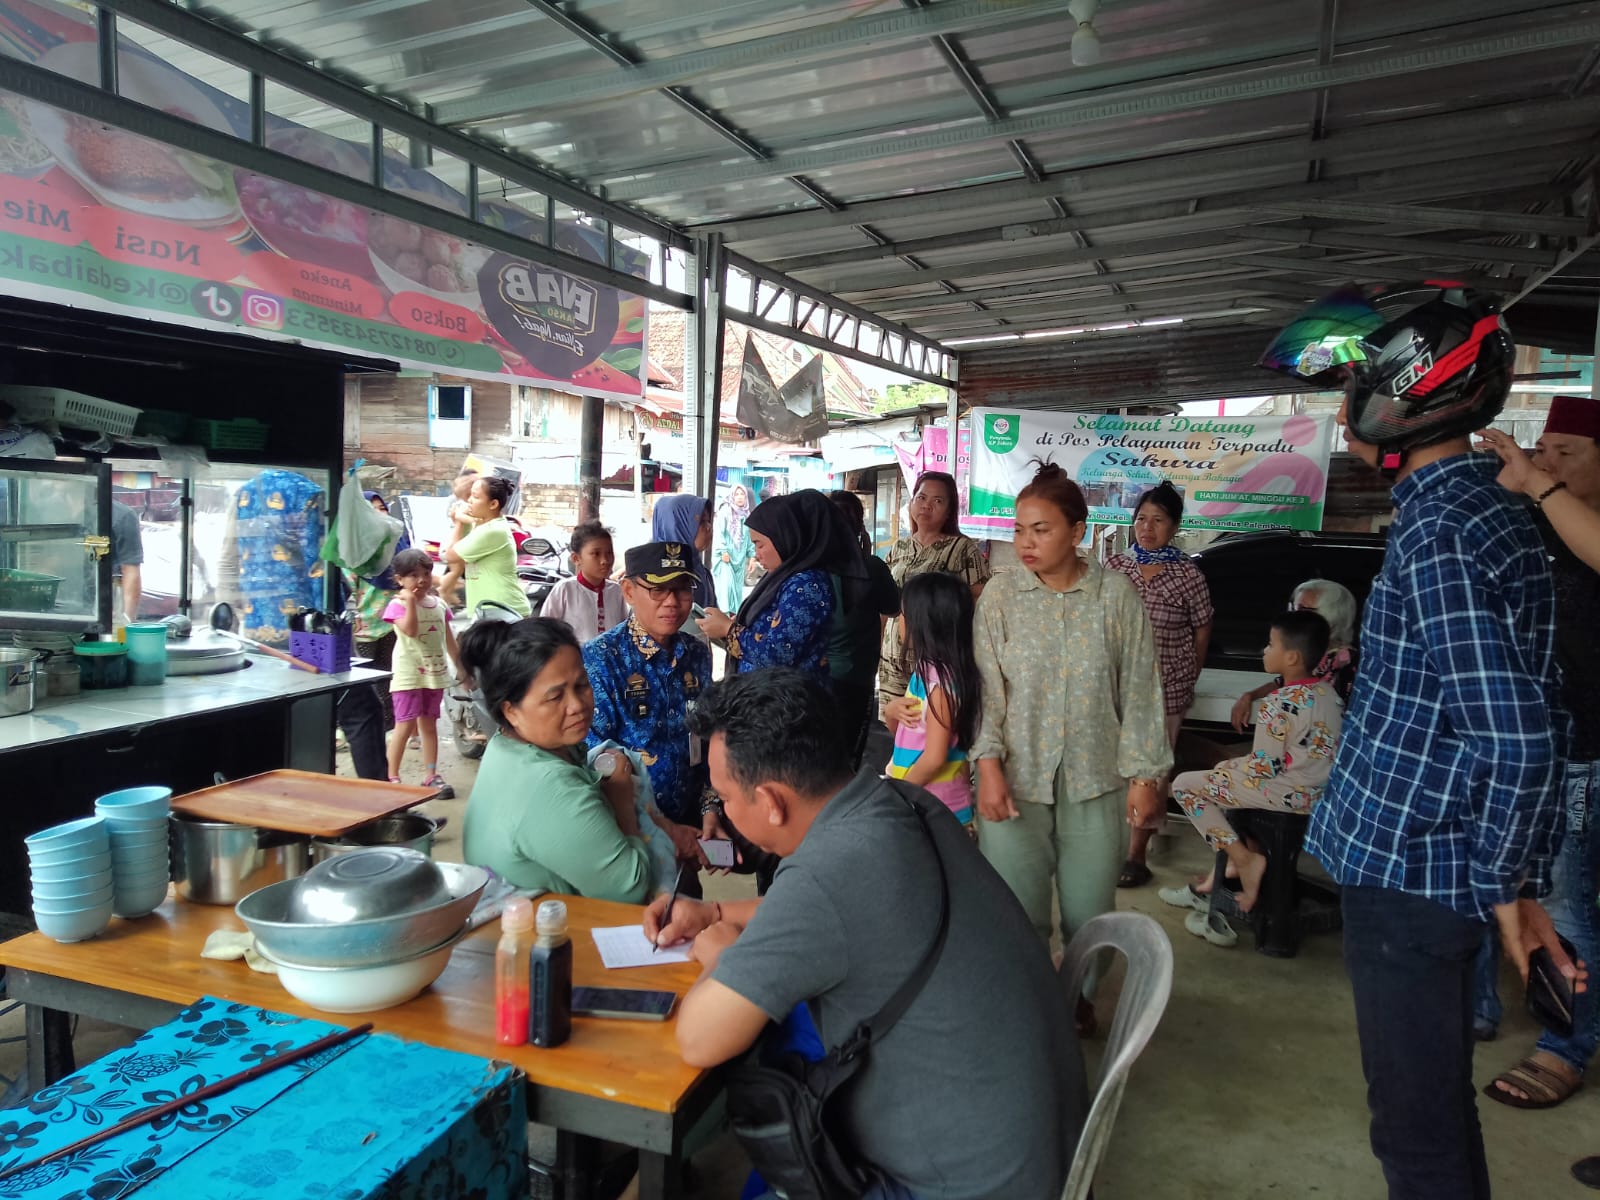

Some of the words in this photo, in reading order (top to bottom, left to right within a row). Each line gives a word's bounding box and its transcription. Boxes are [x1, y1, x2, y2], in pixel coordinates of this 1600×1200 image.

[1392, 351, 1433, 395] GM
[1073, 415, 1162, 432] Selamat
[1168, 416, 1256, 438] Datang
[1036, 431, 1054, 446] di
[1058, 432, 1090, 447] Pos
[1097, 433, 1203, 452] Pelayanan
[1208, 436, 1296, 456] Terpadu
[1101, 451, 1218, 470] Sakura
[1199, 491, 1218, 499] HARI
[1251, 494, 1286, 503] MINGGU
[1209, 519, 1241, 528] Gandus
